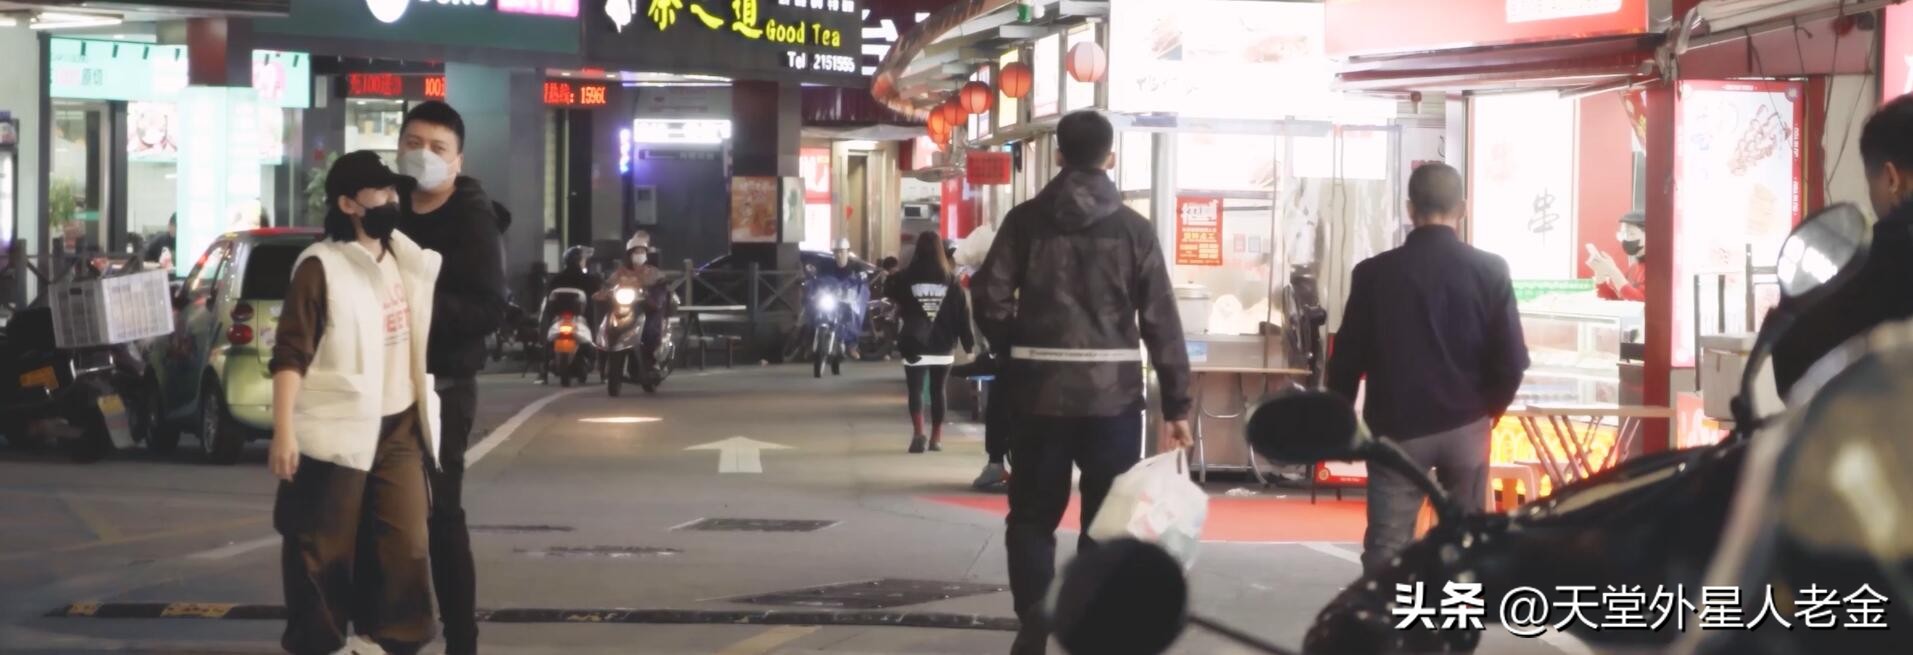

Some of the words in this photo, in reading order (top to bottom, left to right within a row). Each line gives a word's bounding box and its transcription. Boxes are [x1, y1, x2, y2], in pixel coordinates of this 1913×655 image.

[766, 19, 805, 43] Good
[812, 23, 840, 47] Tea
[787, 51, 806, 69] Tel
